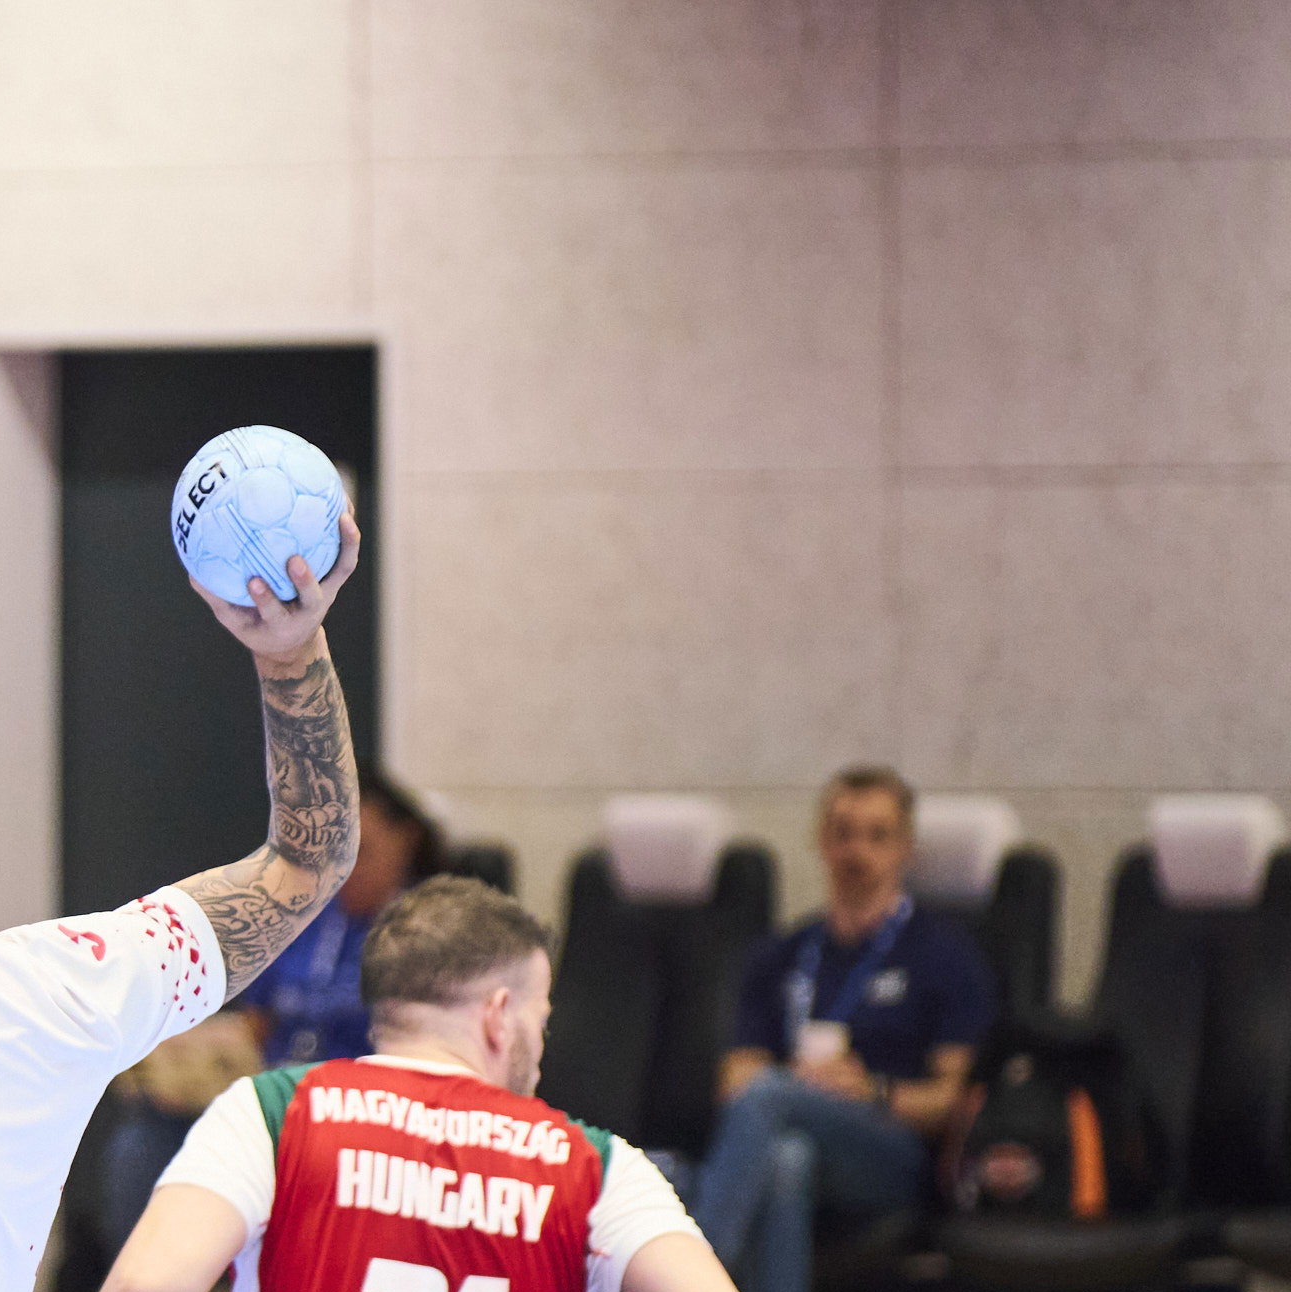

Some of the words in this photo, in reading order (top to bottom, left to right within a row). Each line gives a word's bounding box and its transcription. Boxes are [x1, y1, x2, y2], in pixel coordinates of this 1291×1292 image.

[176, 460, 229, 554] SELECT
[310, 1086, 572, 1166] MAGYARORSZÁG
[335, 1148, 555, 1243] HUNGARY
